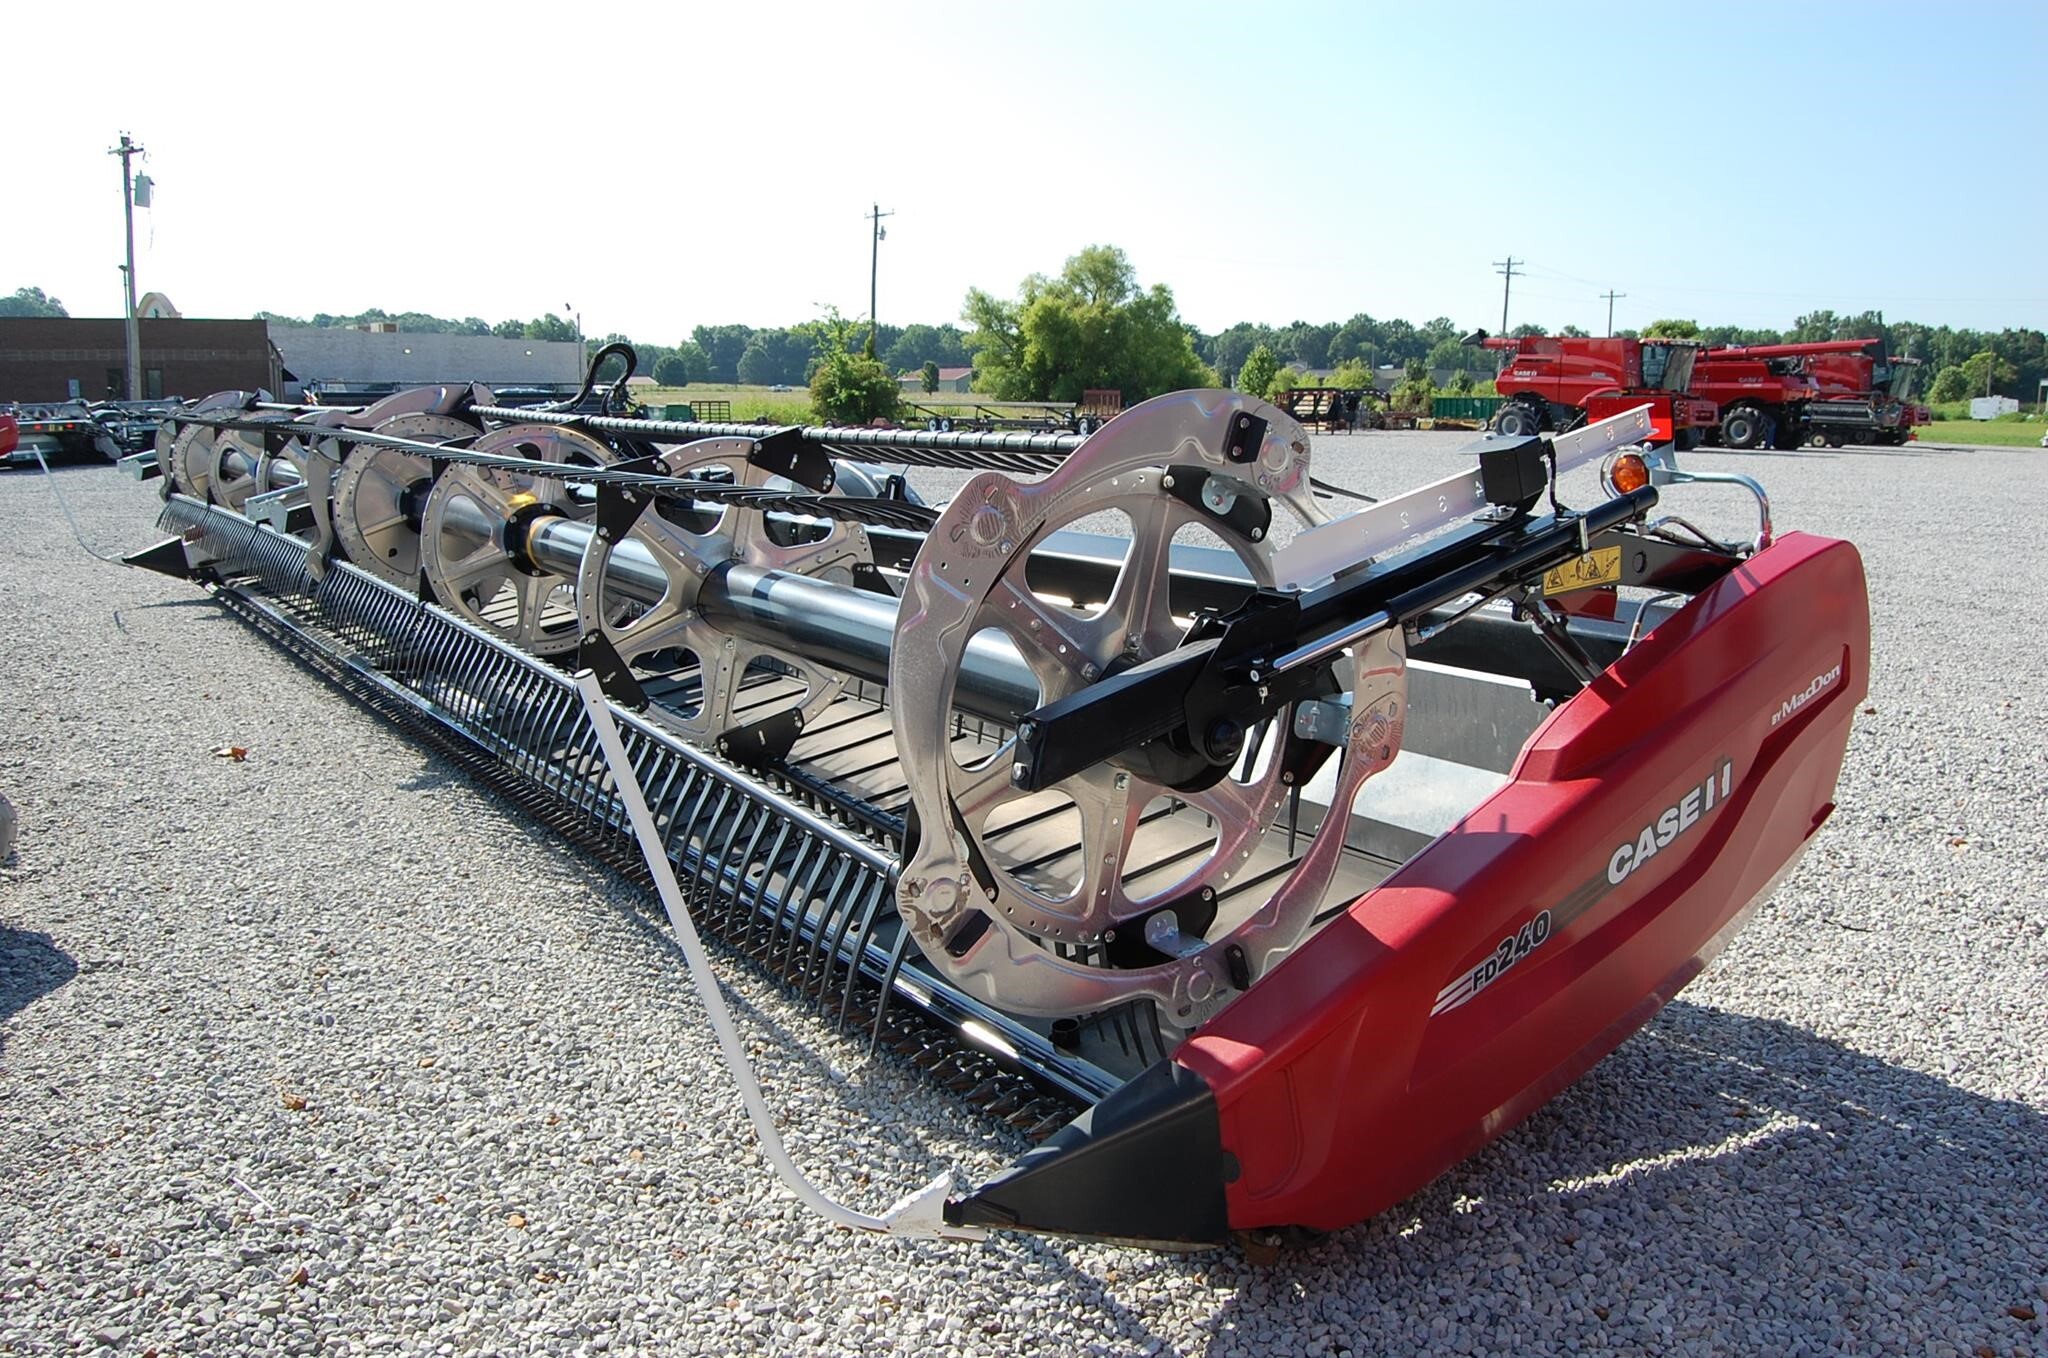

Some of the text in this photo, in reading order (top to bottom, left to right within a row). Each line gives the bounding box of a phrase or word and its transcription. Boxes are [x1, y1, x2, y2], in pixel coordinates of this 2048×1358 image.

[1782, 664, 1841, 718] MacDon
[1607, 785, 1701, 885] CASE
[1472, 909, 1551, 994] FD240
